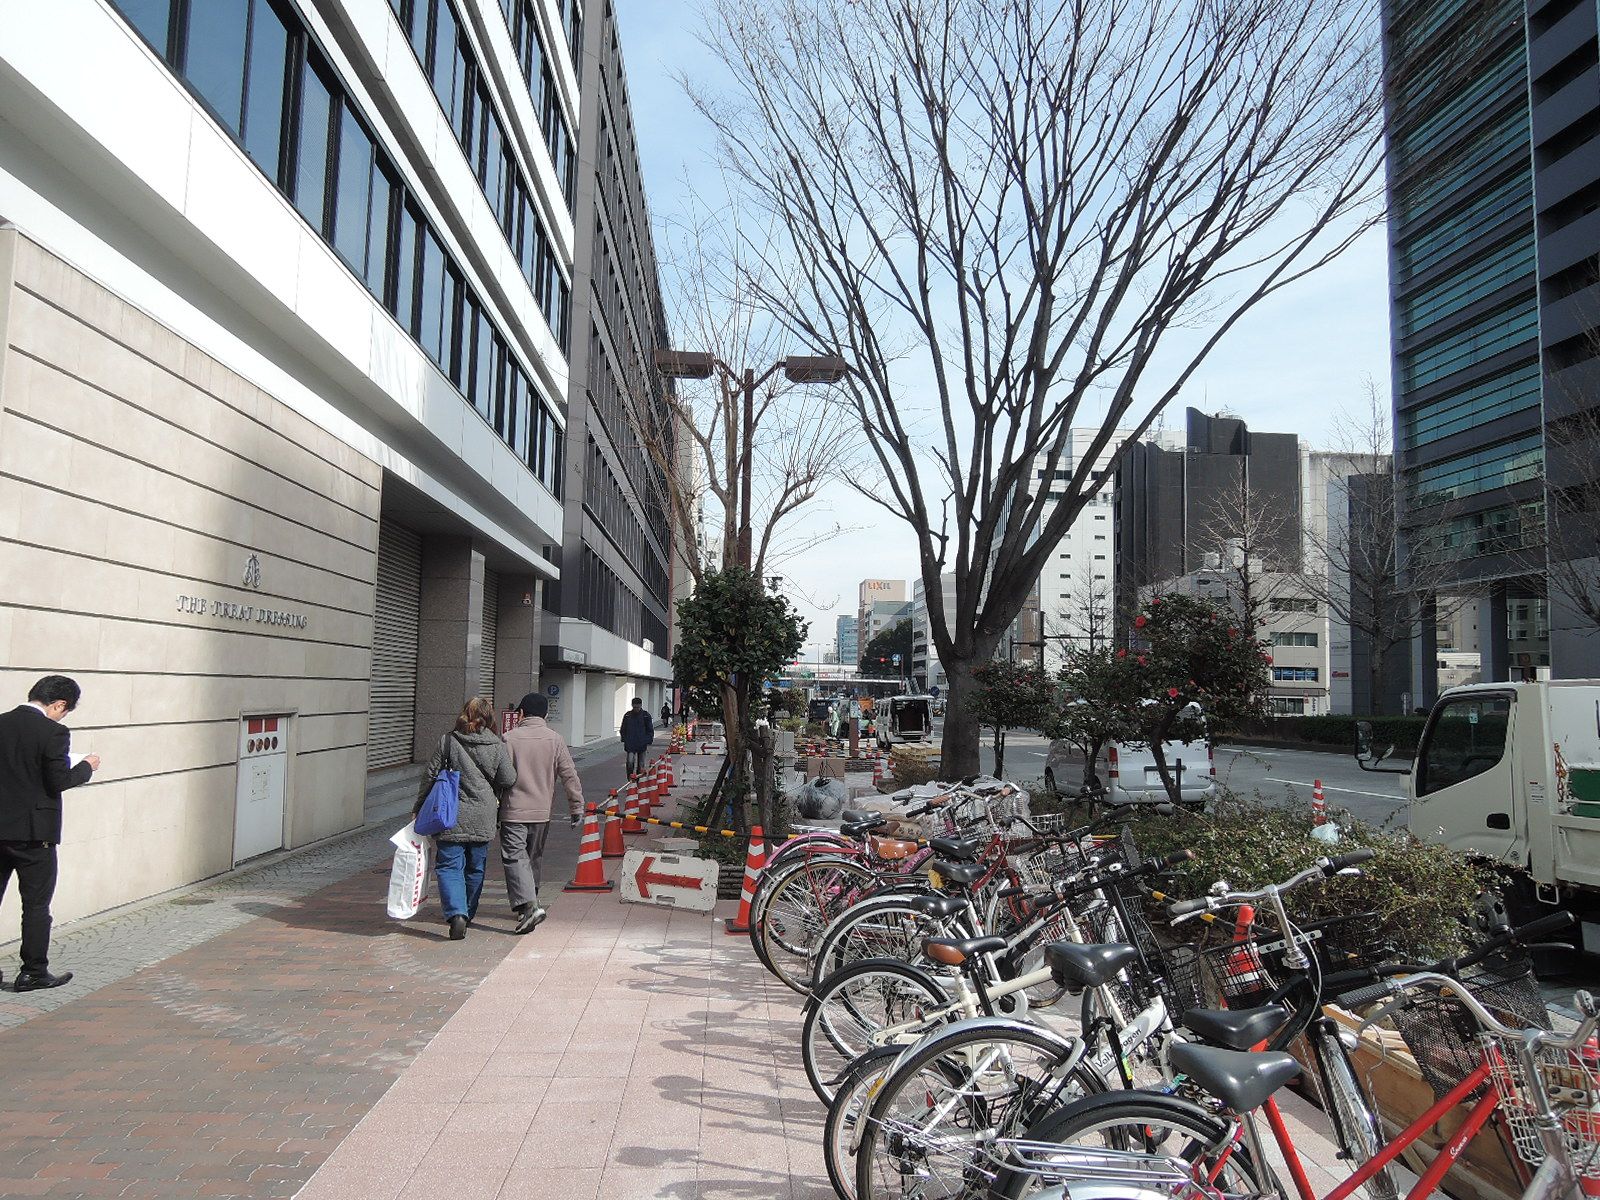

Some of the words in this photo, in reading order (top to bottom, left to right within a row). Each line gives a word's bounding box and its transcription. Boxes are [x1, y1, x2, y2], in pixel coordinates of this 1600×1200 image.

[867, 581, 891, 591] LIXIL
[177, 595, 207, 615] THE
[211, 600, 253, 620] TREAT
[255, 608, 307, 629] DRESSING
[1095, 1028, 1142, 1068] Volkagen
